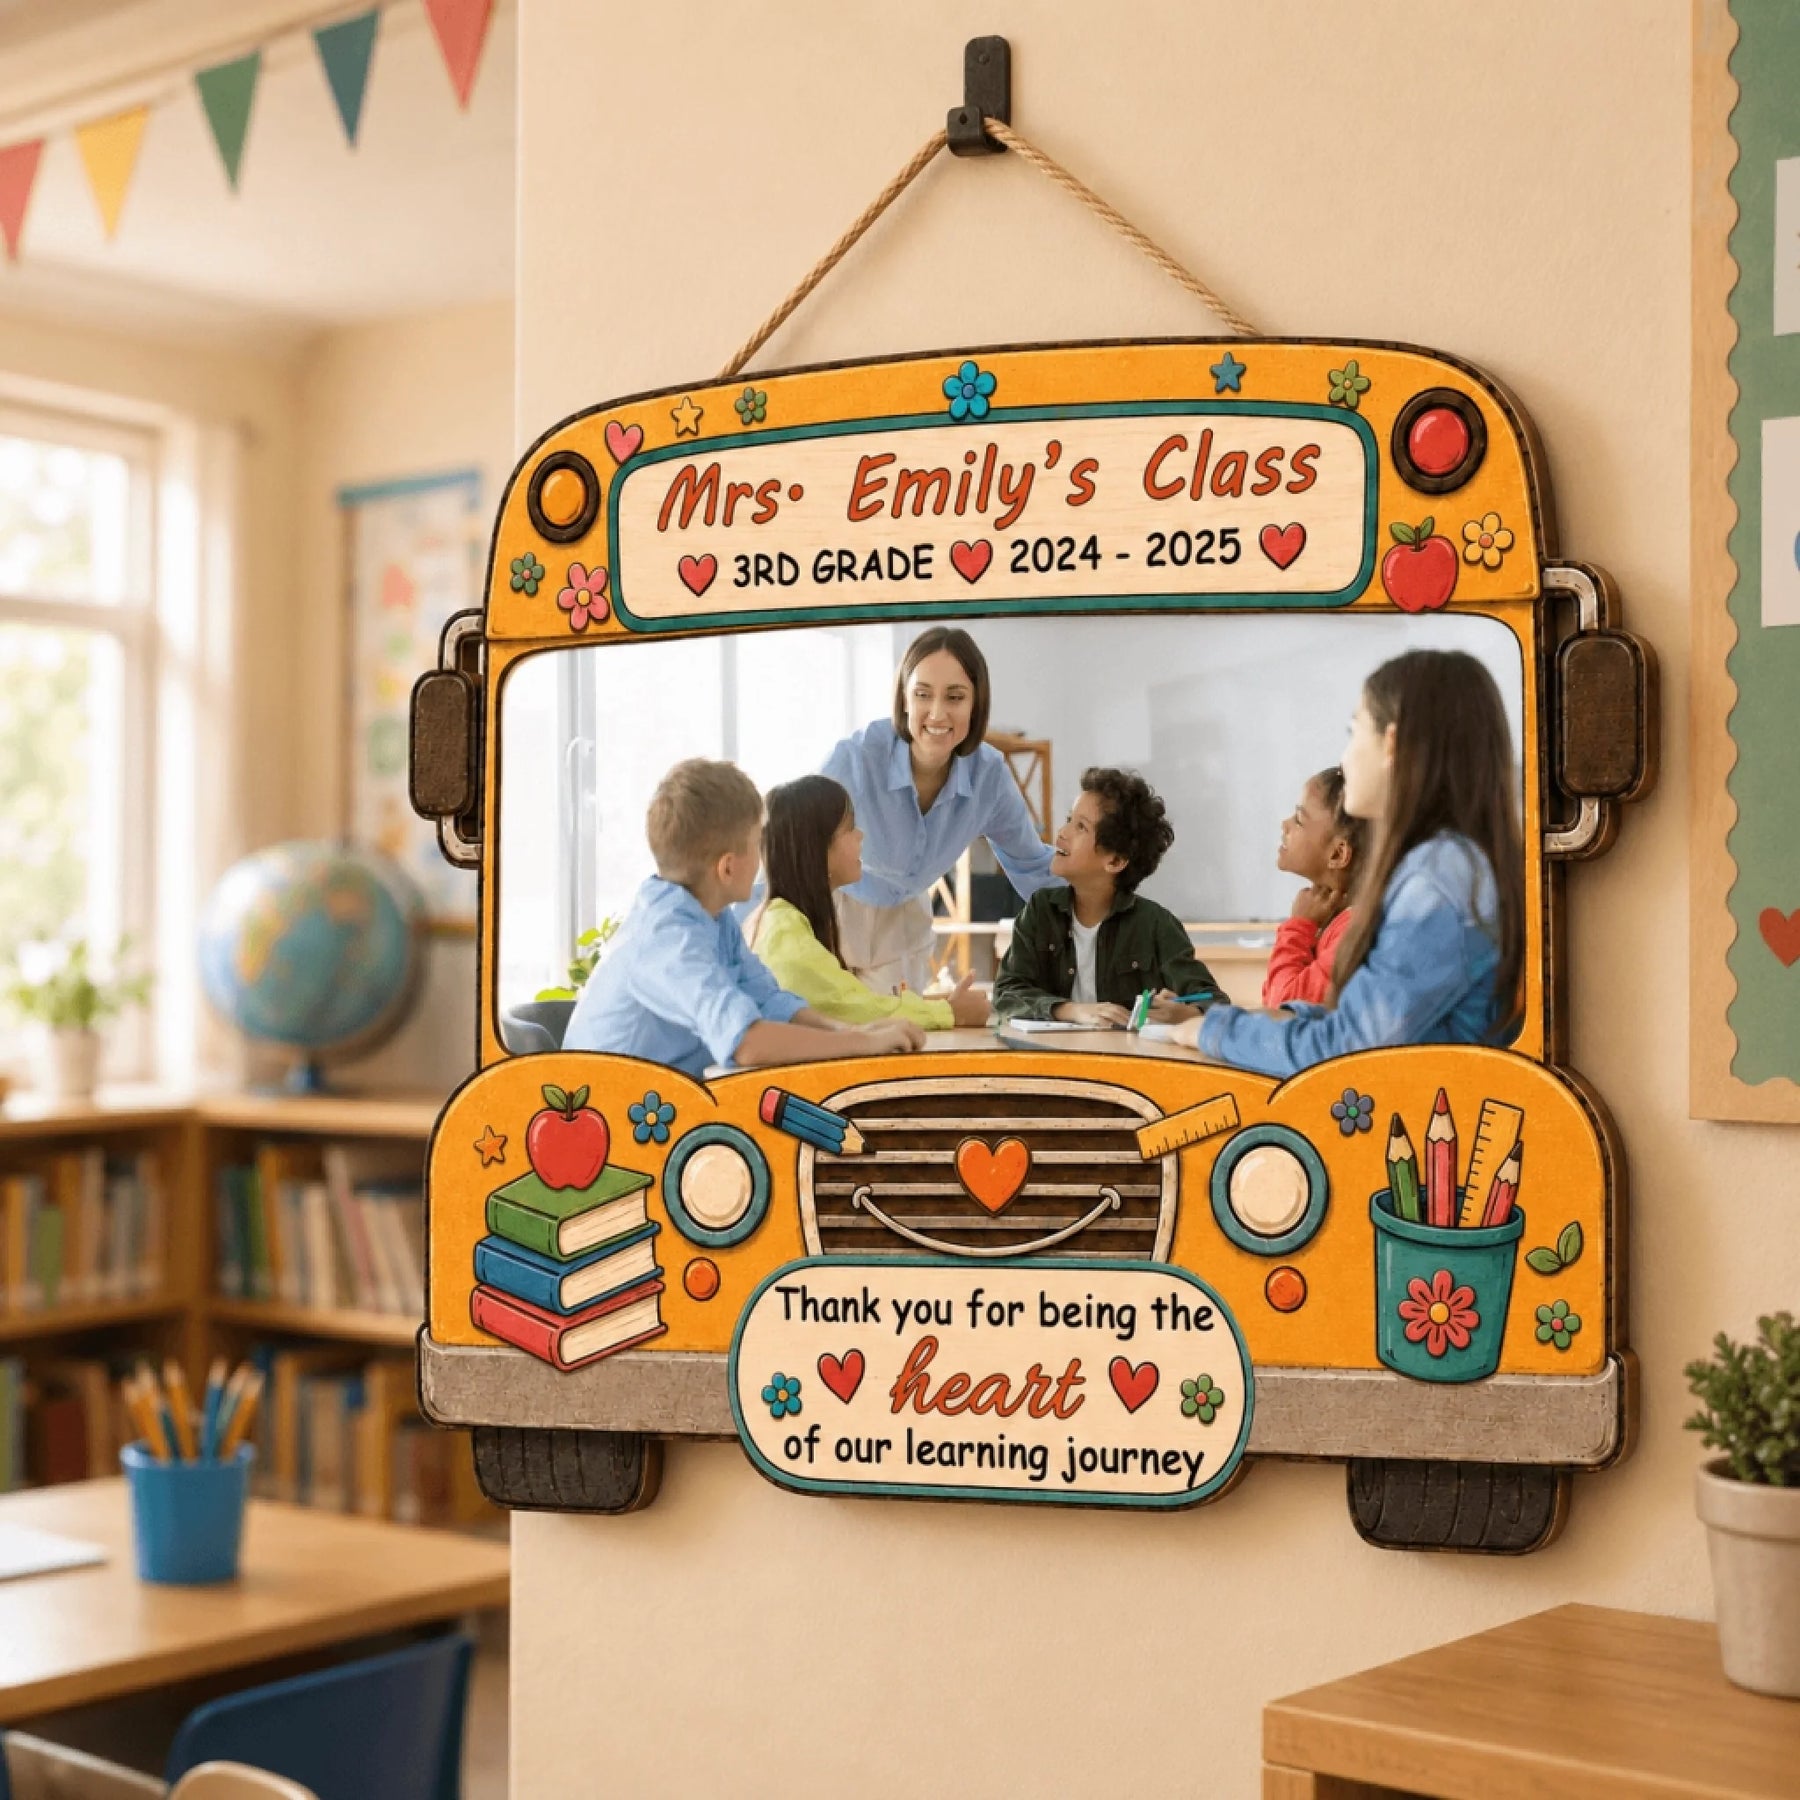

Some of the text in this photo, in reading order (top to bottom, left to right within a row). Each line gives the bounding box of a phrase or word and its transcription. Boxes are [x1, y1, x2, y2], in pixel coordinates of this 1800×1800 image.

[847, 440, 1099, 531] Emily’s
[1143, 429, 1321, 501] Class
[733, 552, 800, 587] 3RD
[812, 543, 934, 584] GRADE
[1010, 534, 1102, 573] 2024
[1146, 527, 1241, 568] 2025
[775, 1285, 1215, 1341] Thank you for being the
[889, 1335, 1086, 1420] heart
[784, 1424, 1205, 1490] of our learning journey
